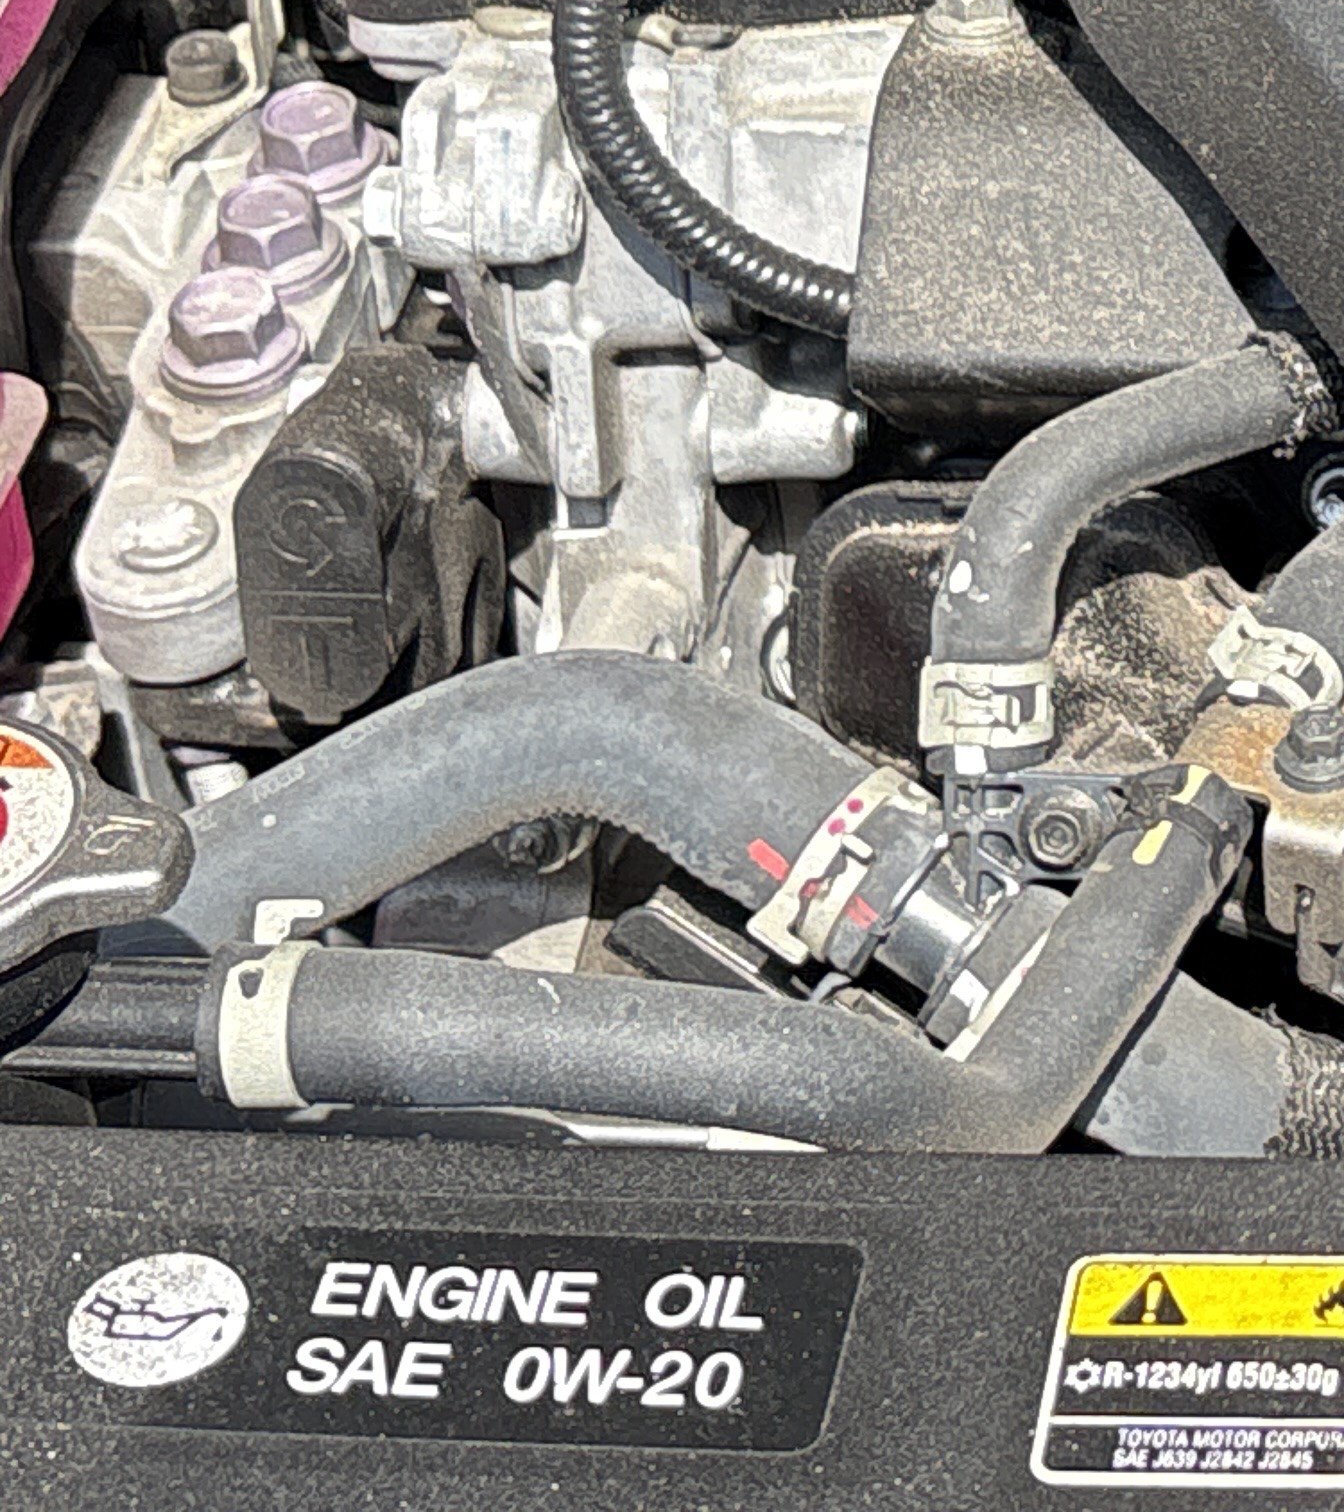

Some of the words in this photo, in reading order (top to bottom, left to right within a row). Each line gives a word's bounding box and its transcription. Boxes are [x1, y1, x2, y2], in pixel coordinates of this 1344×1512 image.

[311, 1262, 598, 1324] ENGINE
[644, 1274, 763, 1330] OIL
[286, 1338, 451, 1399] SAE
[503, 1346, 744, 1410] 0W-20
[1102, 1360, 1222, 1395] R-1234yf
[1226, 1361, 1340, 1396] 650±30g
[1116, 1428, 1189, 1447] TOYOTA
[1192, 1429, 1261, 1448] MOTOR
[1112, 1448, 1149, 1468] SAE
